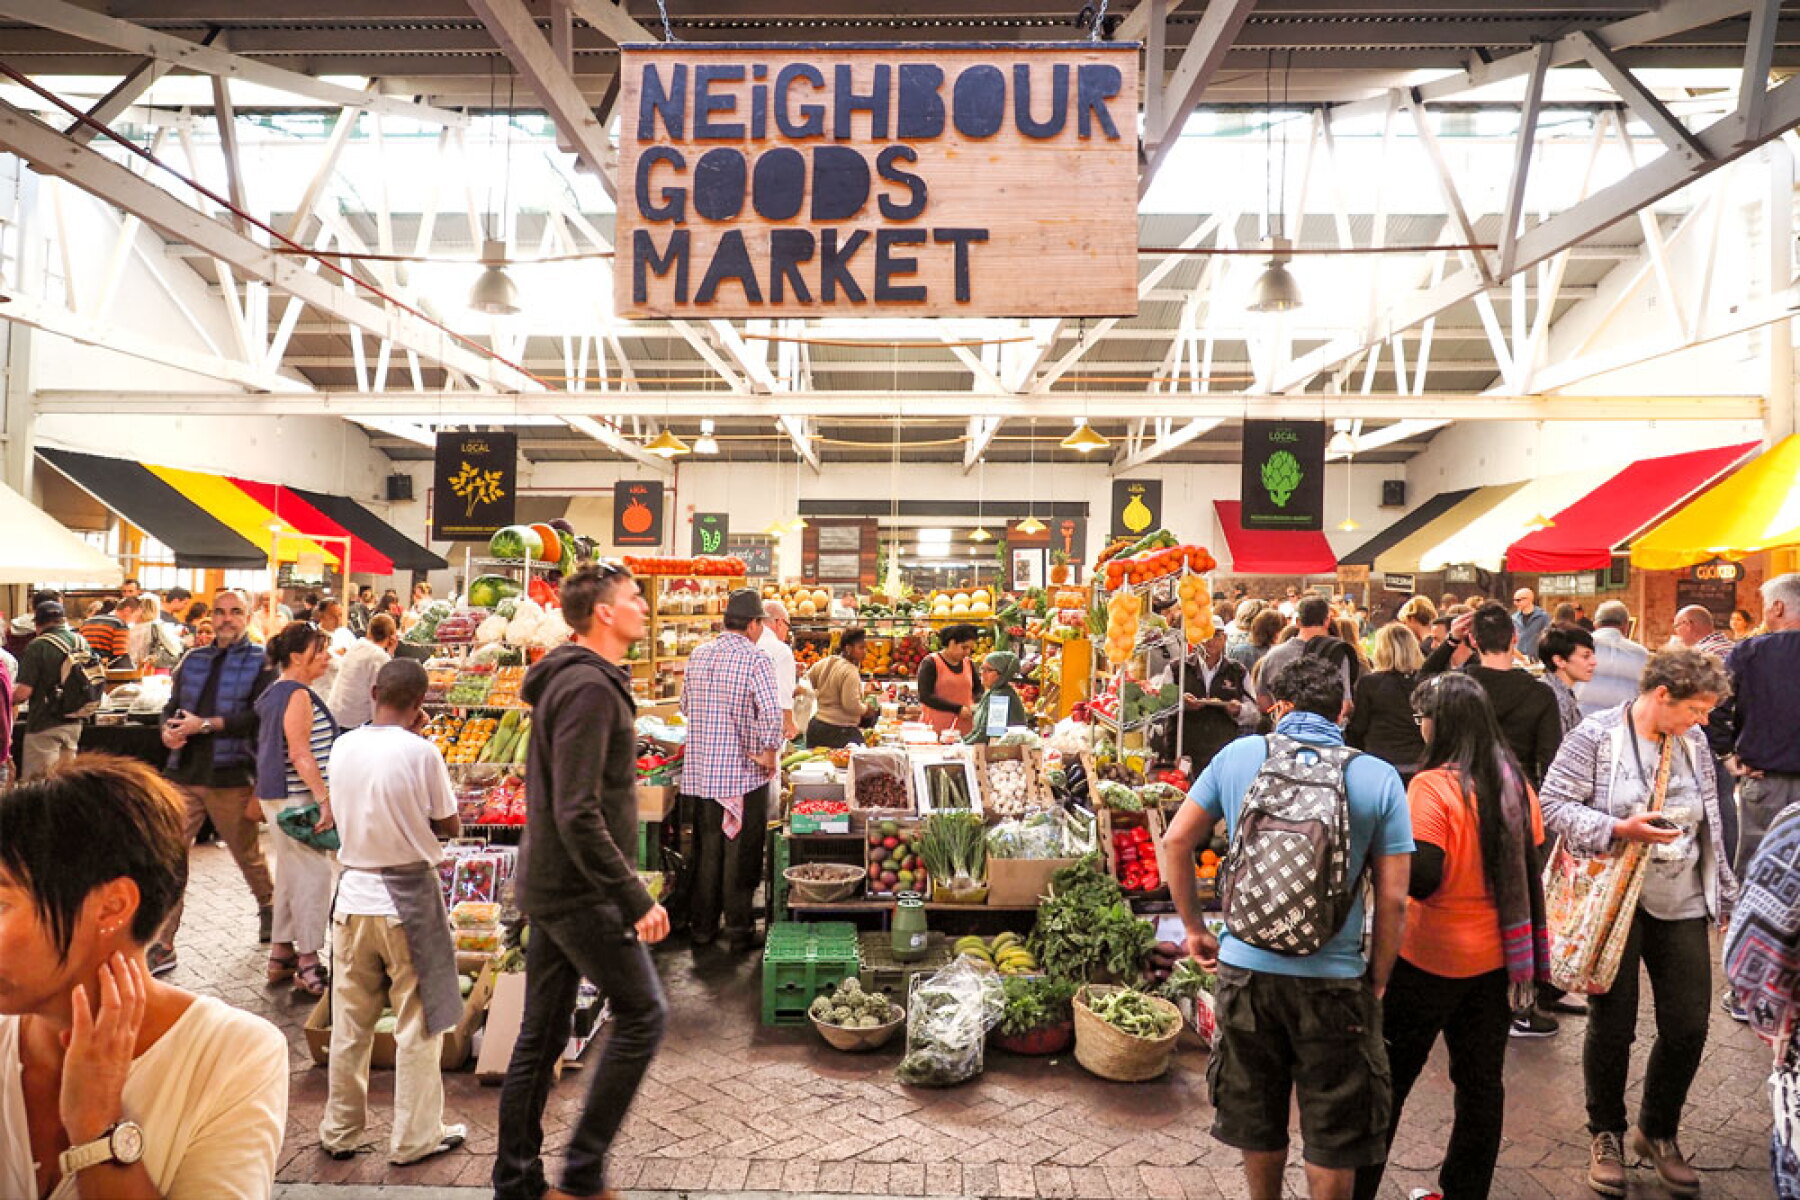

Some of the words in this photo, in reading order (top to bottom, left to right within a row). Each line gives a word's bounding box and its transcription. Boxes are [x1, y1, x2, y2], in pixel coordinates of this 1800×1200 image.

[635, 145, 928, 225] GOODS
[633, 228, 989, 304] MARKET
[461, 443, 490, 453] LOCAL
[1268, 431, 1299, 441] LOCAL
